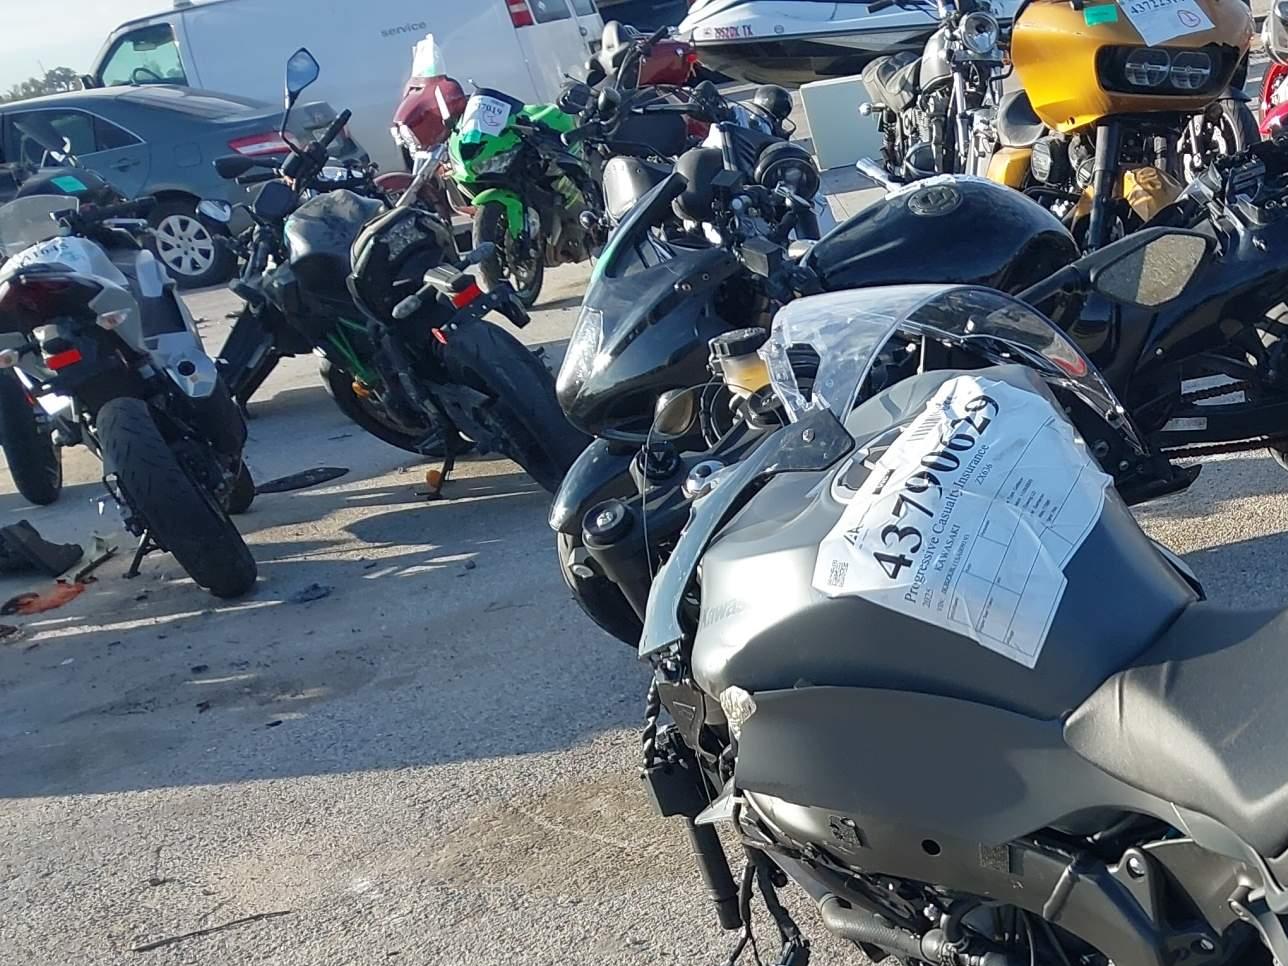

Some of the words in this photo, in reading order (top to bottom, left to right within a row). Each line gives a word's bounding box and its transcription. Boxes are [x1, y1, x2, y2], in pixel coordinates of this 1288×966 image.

[873, 395, 999, 579] 43790629
[904, 535, 940, 603] Progressive
[932, 488, 964, 534] Casualty
[953, 444, 990, 489] Insurance
[935, 524, 961, 571] KAWASAKI
[975, 463, 993, 486] ZX636
